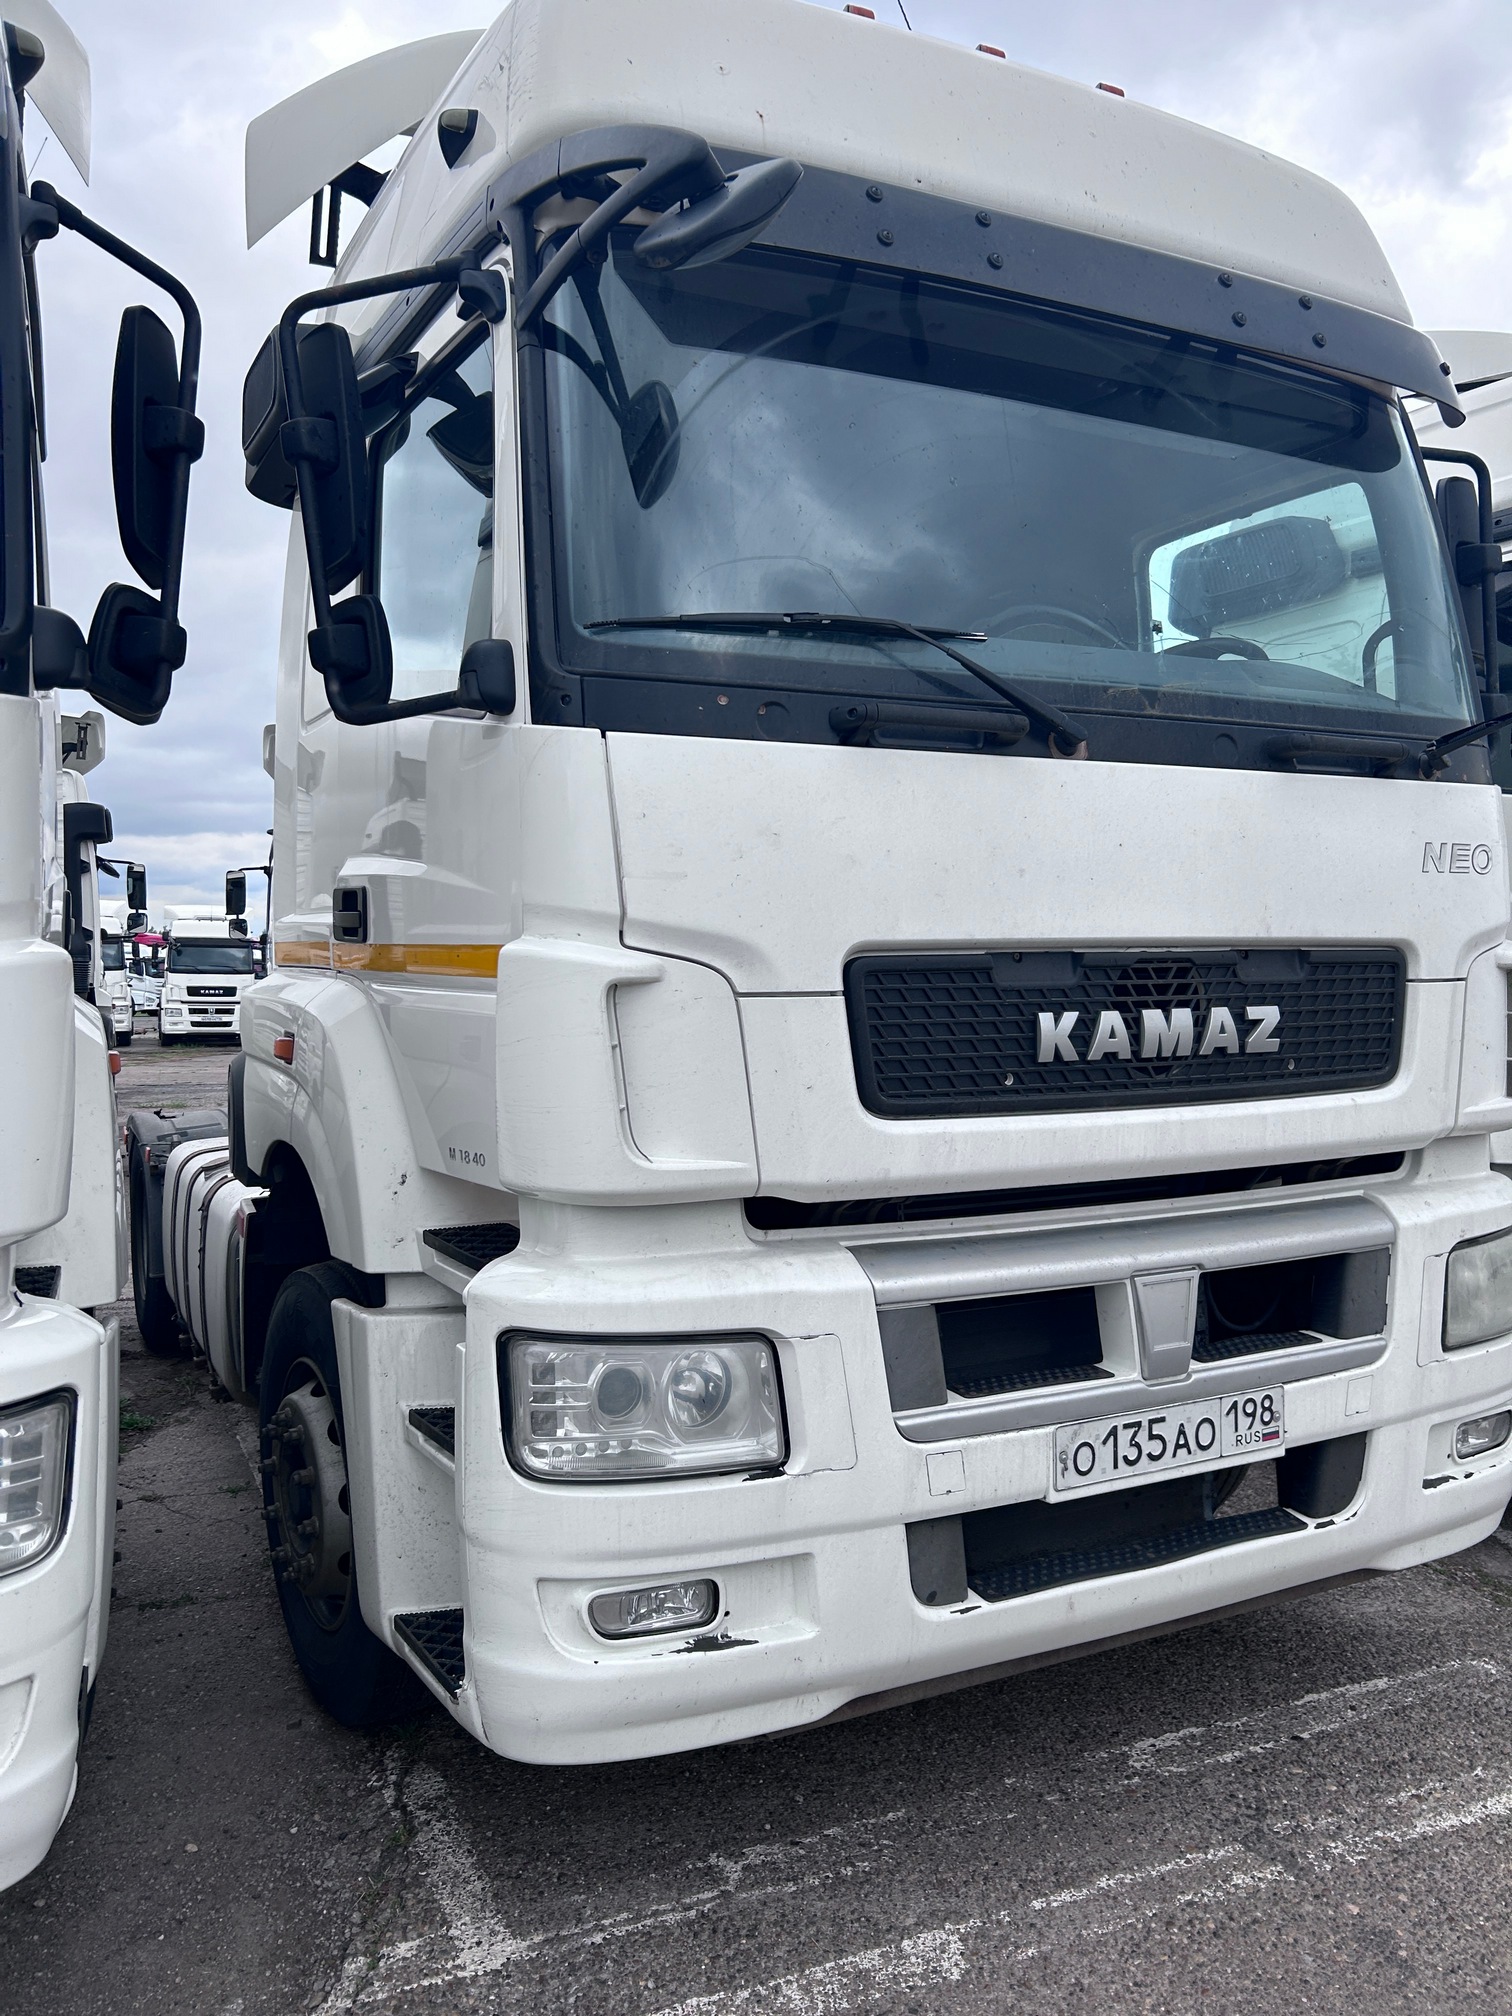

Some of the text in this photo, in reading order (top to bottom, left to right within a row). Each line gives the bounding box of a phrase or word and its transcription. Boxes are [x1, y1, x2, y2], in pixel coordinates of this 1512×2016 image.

[1421, 841, 1493, 875] NEO
[1037, 1005, 1281, 1063] KAMAZ
[448, 1146, 486, 1167] M 1840
[1224, 1393, 1275, 1433] 198
[1235, 1431, 1262, 1448] RUS
